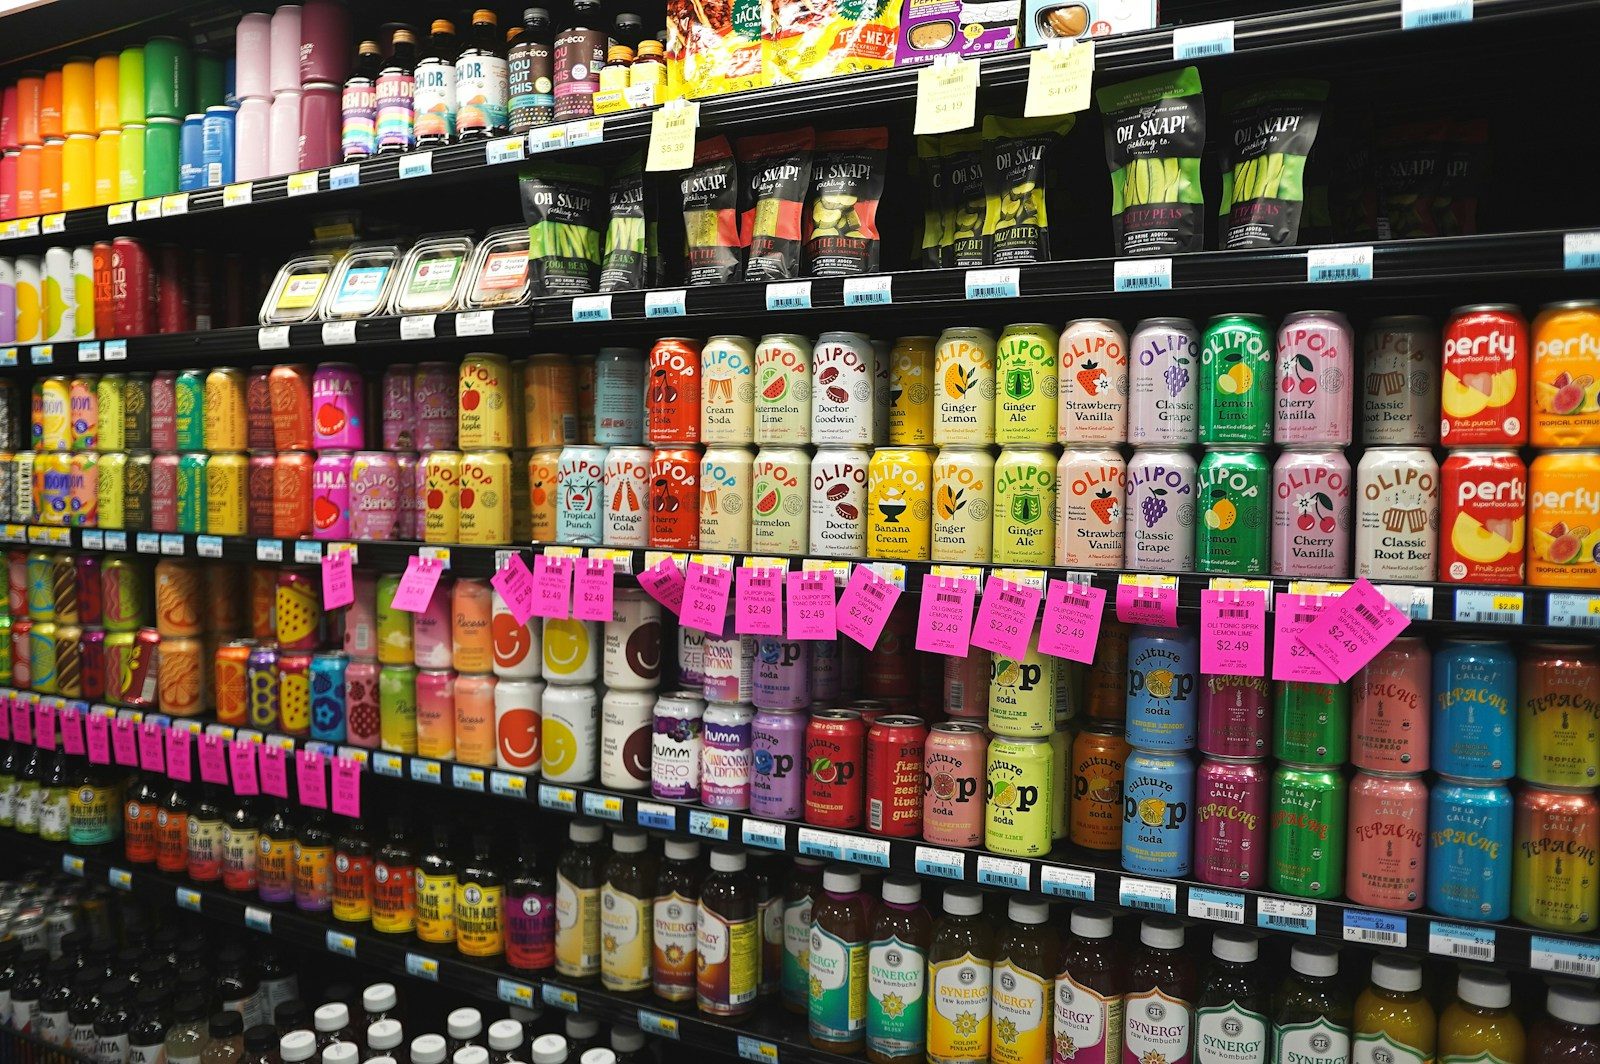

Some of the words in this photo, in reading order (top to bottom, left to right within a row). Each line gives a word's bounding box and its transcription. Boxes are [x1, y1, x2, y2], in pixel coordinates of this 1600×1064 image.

[509, 60, 530, 73] YOU
[509, 71, 529, 84] GUT
[510, 82, 532, 95] THIS
[1117, 125, 1133, 144] OH
[1138, 116, 1187, 138] SNAP!
[1234, 126, 1252, 146] OH
[1255, 116, 1299, 138] SNAP!
[1126, 138, 1157, 153] pickling
[534, 192, 552, 204] OH
[558, 194, 591, 212] SNAP!
[1202, 332, 1271, 365] OLIPOP
[1444, 331, 1517, 364] perfy
[1534, 333, 1600, 363] perfy
[1062, 338, 1127, 368] OLIPOP
[818, 404, 850, 413] Doctor
[941, 403, 977, 414] Ginger
[1003, 402, 1036, 412] Ginger
[1066, 401, 1122, 411] Strawberry
[1156, 400, 1194, 409] Classic
[1214, 399, 1254, 408] Lemon
[1279, 398, 1315, 409] Cherry
[1365, 400, 1404, 411] Classic
[706, 406, 734, 415] Cream
[1219, 411, 1248, 420] Lime
[1278, 410, 1316, 420] Vanilla
[461, 413, 480, 423] Crisp
[708, 416, 731, 424] Soda
[762, 415, 783, 423] Lime
[815, 415, 855, 424] Goodwin
[941, 414, 978, 423] Lemon
[1009, 413, 1027, 422] Ale
[1075, 412, 1113, 421] Vanilla
[1158, 412, 1192, 423] Grape
[461, 422, 481, 431] Apple
[1454, 419, 1471, 427] fruit
[1473, 419, 1496, 427] punch
[1127, 467, 1191, 496] OLIPOP
[1277, 468, 1349, 499] OLIPOP
[361, 498, 396, 512] Barbie
[1533, 488, 1600, 516] perfy
[563, 511, 596, 521] Tropical
[609, 513, 642, 524] Vintage
[566, 520, 592, 529] Punch
[613, 522, 635, 531] Cola
[826, 521, 859, 529] Doctor
[874, 524, 910, 533] Banana
[934, 524, 966, 534] Ginger
[755, 529, 774, 537] Lime
[821, 531, 863, 540] Goodwin
[1008, 526, 1044, 536] Ginger
[1135, 530, 1174, 540] Classic
[876, 534, 909, 544] Cream
[934, 534, 966, 544] Lemon
[1016, 537, 1035, 546] Ale
[1201, 533, 1237, 544] Lemon
[1294, 536, 1334, 546] Cherry
[1382, 537, 1427, 548] Classic
[1089, 540, 1122, 549] Vanilla
[1137, 542, 1170, 552] Grape
[1292, 548, 1335, 558] Vanilla
[1374, 549, 1405, 560] Root
[1408, 549, 1432, 560] Beer
[1493, 565, 1516, 574] punch
[542, 590, 561, 599] $2.49
[584, 593, 604, 602] $2.49
[694, 600, 716, 612] $2.49
[748, 604, 772, 614] $2.49
[1498, 602, 1520, 610] $2.89
[800, 610, 825, 619] $2.49
[990, 609, 1012, 620] GINGER
[1012, 616, 1024, 624] ALE
[1055, 624, 1085, 638] $2.49
[1216, 640, 1249, 652] $2.49
[1134, 647, 1181, 666] culture
[760, 671, 778, 679] soda
[1456, 672, 1497, 684] CALLE!
[996, 695, 1017, 705] soda
[1439, 687, 1509, 715] TEPACHE
[1145, 707, 1171, 716] soda
[705, 726, 740, 742] humm
[1079, 756, 1121, 772] culture
[1543, 755, 1587, 764] TROPICAL
[754, 781, 771, 790] soda
[1128, 777, 1173, 794] culture
[1210, 790, 1246, 802] CALLE!
[1281, 798, 1317, 812] CALLE!
[933, 807, 954, 816] soda
[1089, 810, 1112, 819] soda
[993, 816, 1014, 826] soda
[1138, 834, 1163, 844] soda
[1355, 822, 1424, 848] TEPACHE
[1522, 838, 1598, 866] TEPACHE
[1225, 901, 1243, 909] $3.29
[1347, 915, 1384, 923] WATERMELON
[1375, 922, 1395, 931] $2.89
[1474, 937, 1496, 946] $3.29
[1577, 953, 1600, 962] $3.29
[871, 965, 920, 981] SYNERGY
[883, 980, 917, 988] kombucha
[1129, 1018, 1184, 1037] SYNERGY
[1142, 1035, 1181, 1045] kombucha
[1202, 1033, 1260, 1053] SYNERGY
[996, 1044, 1018, 1055] GOLDEN
[1204, 1047, 1216, 1055] raw
[1219, 1051, 1257, 1060] kombucha
